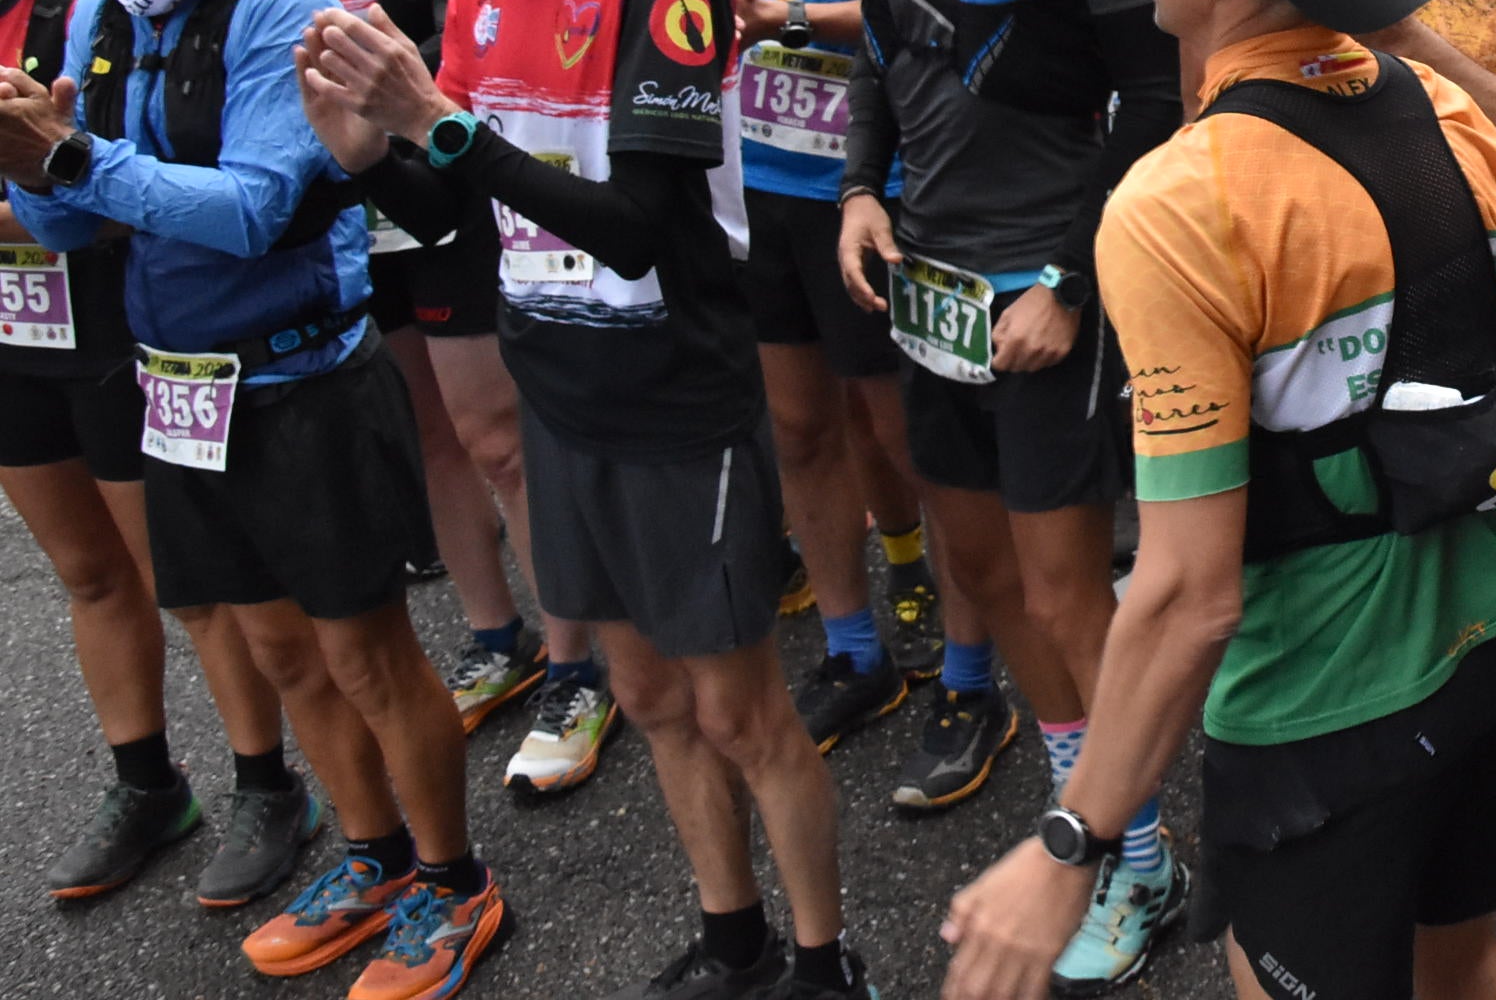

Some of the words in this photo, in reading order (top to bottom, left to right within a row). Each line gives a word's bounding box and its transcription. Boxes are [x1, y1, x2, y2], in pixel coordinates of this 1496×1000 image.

[753, 69, 848, 123] 1357
[903, 282, 978, 349] 1137
[145, 378, 218, 429] 1356
